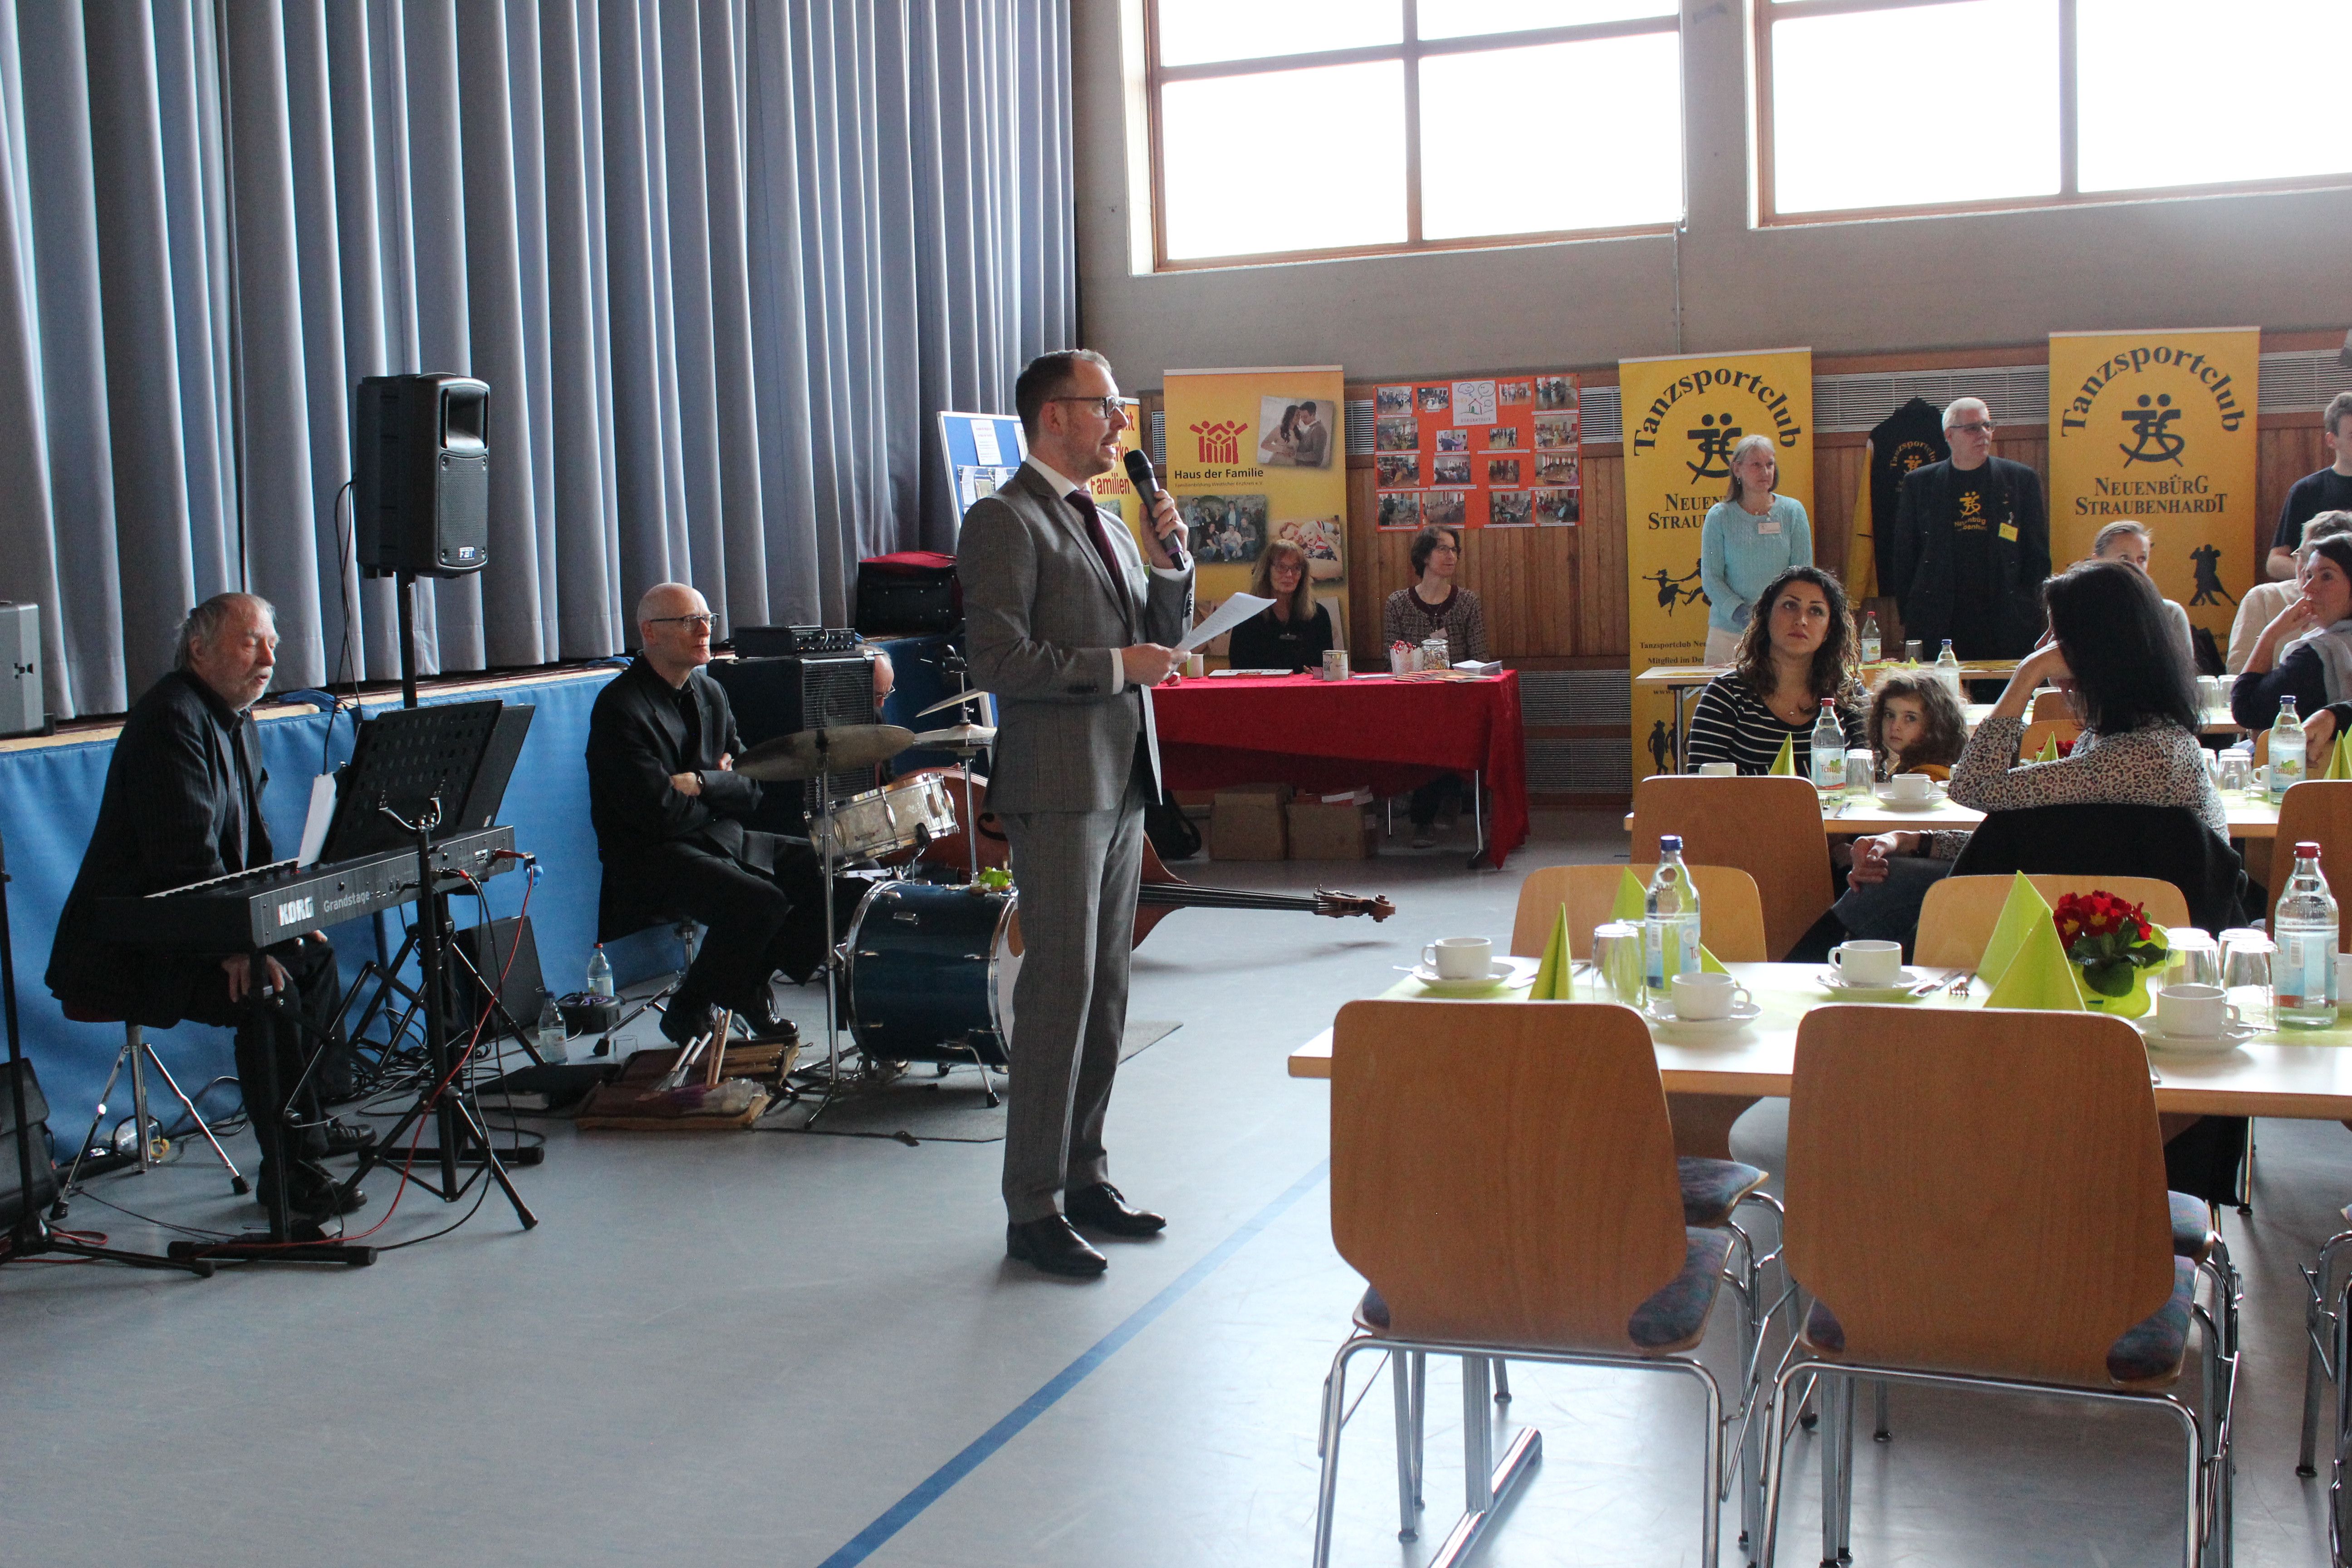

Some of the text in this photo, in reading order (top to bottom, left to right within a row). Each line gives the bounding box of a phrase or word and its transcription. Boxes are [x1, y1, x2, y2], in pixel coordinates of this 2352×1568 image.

[2061, 347, 2245, 437] Tanzsportclub
[1634, 368, 1801, 456] Tanzsportclub
[1090, 472, 1130, 495] Familien
[1175, 468, 1264, 479] Haus der Familie
[2095, 474, 2208, 496] NEUENBÜRG
[1665, 493, 1725, 511] NEUEN
[2075, 494, 2227, 515] STRAUBENHARDT
[1649, 512, 1705, 530] STRAU
[1640, 641, 1691, 650] Tanzsportclub
[278, 896, 315, 926] KORG
[323, 891, 370, 913] Grandstage
